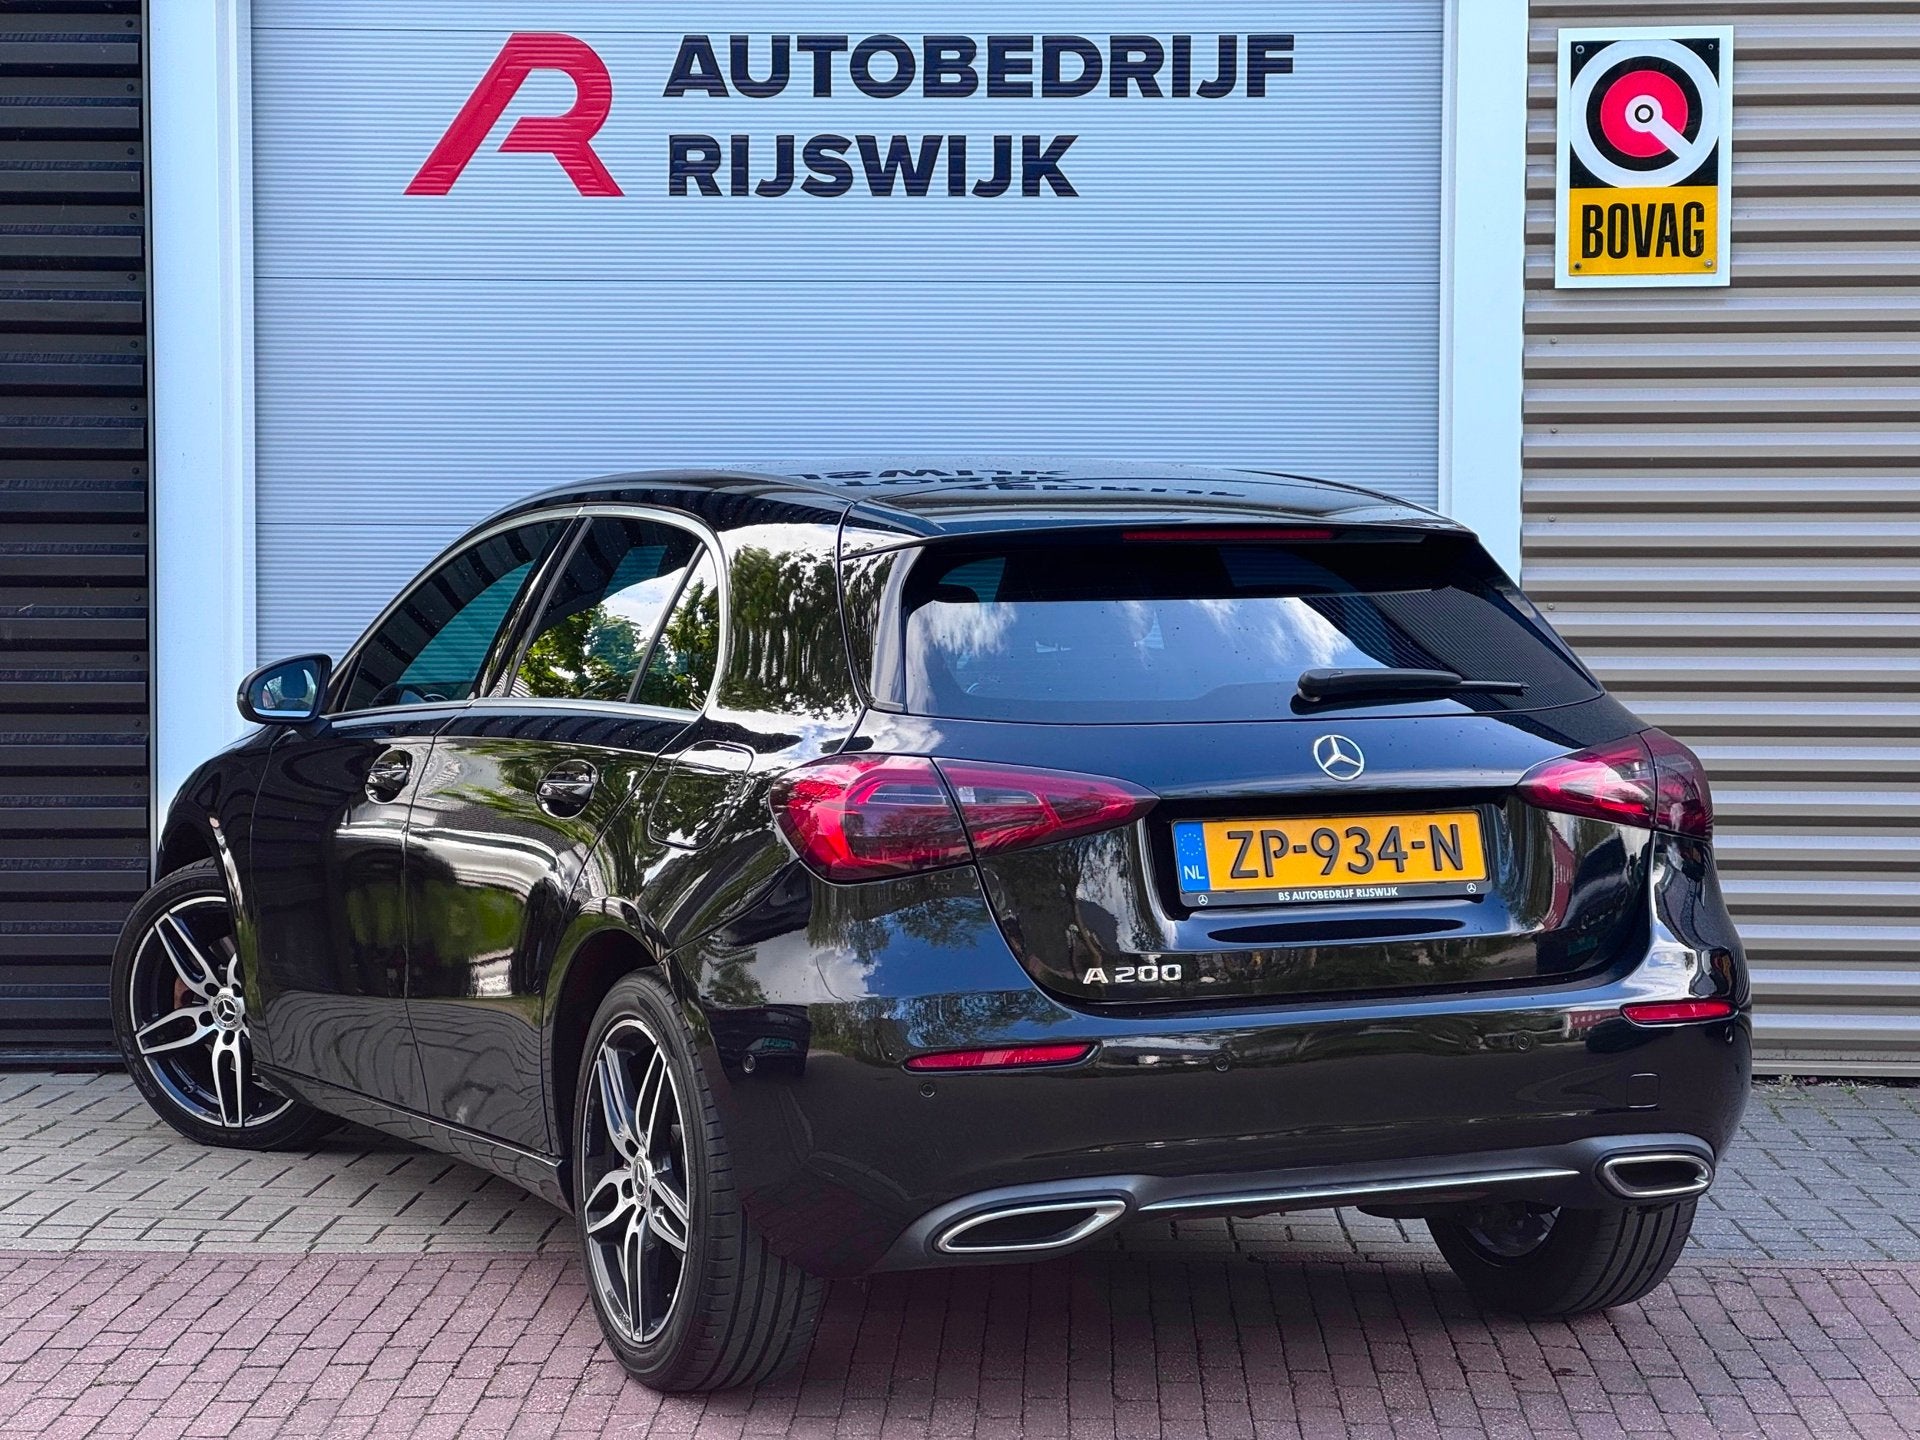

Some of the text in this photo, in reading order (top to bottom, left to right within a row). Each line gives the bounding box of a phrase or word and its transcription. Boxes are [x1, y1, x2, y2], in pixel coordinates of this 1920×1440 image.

[663, 34, 1294, 98] AUTOBEDRIJF
[668, 134, 1079, 198] RIJSWIJK
[1581, 201, 1705, 259] BOVAG
[1183, 865, 1205, 880] NL
[1227, 824, 1464, 879] ZP-934-N
[1278, 887, 1398, 901] BS AUTOBEDRIJF RIJSWIJK
[1082, 964, 1182, 985] A 200
